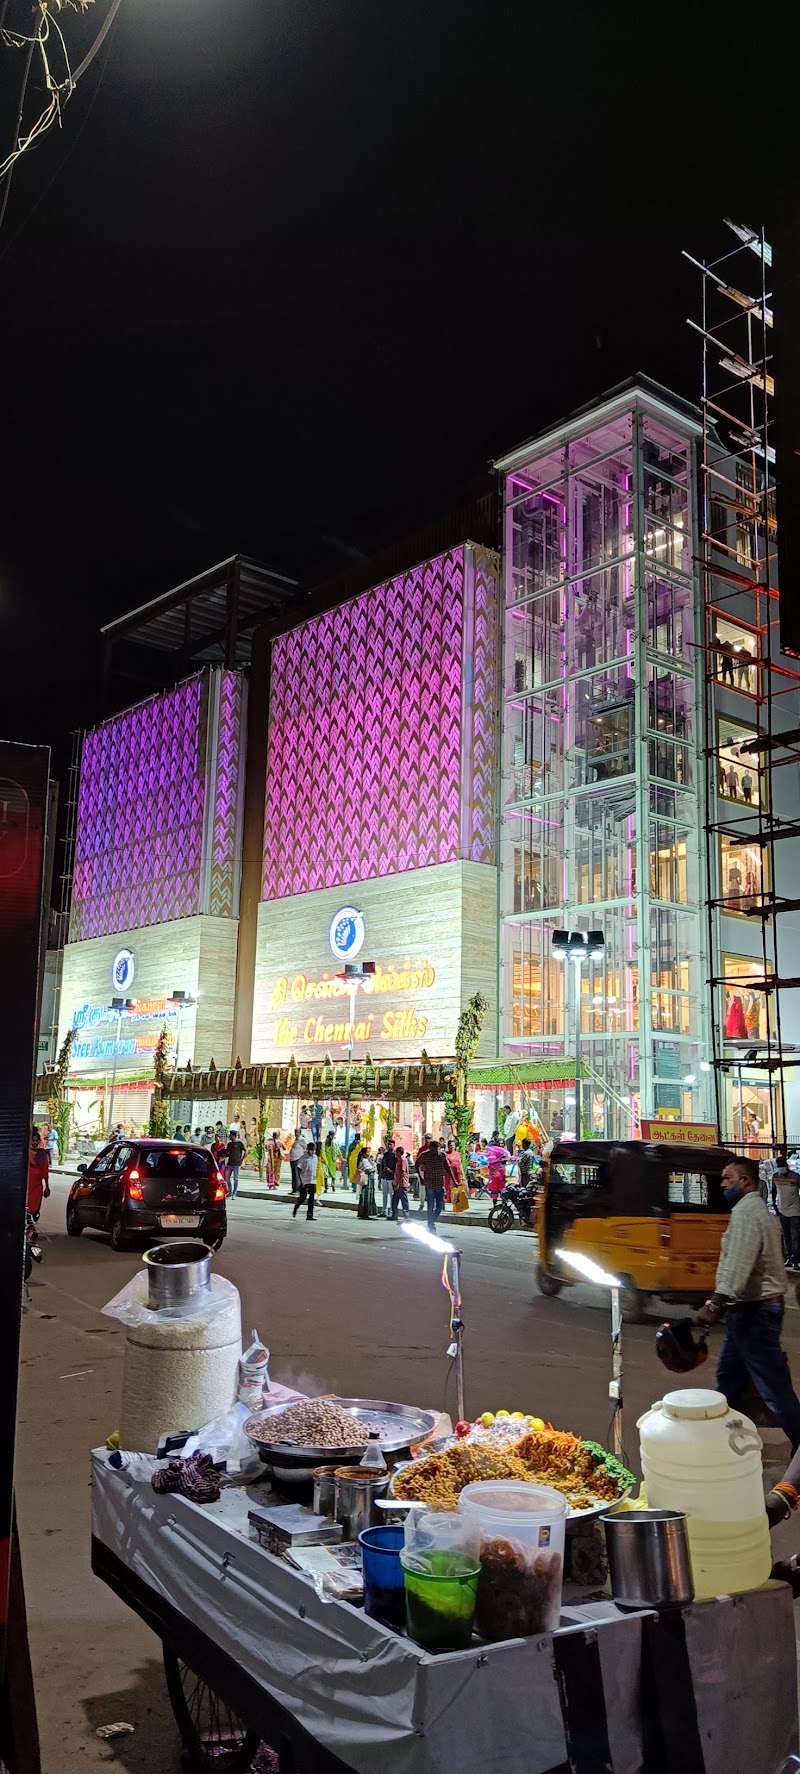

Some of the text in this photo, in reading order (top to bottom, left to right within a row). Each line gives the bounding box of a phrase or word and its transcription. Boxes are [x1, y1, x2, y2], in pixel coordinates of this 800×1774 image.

[273, 1008, 428, 1046] The Chennai Silks
[71, 1037, 91, 1058] Sree
[652, 1129, 716, 1142] ஆட்கள் தேவை
